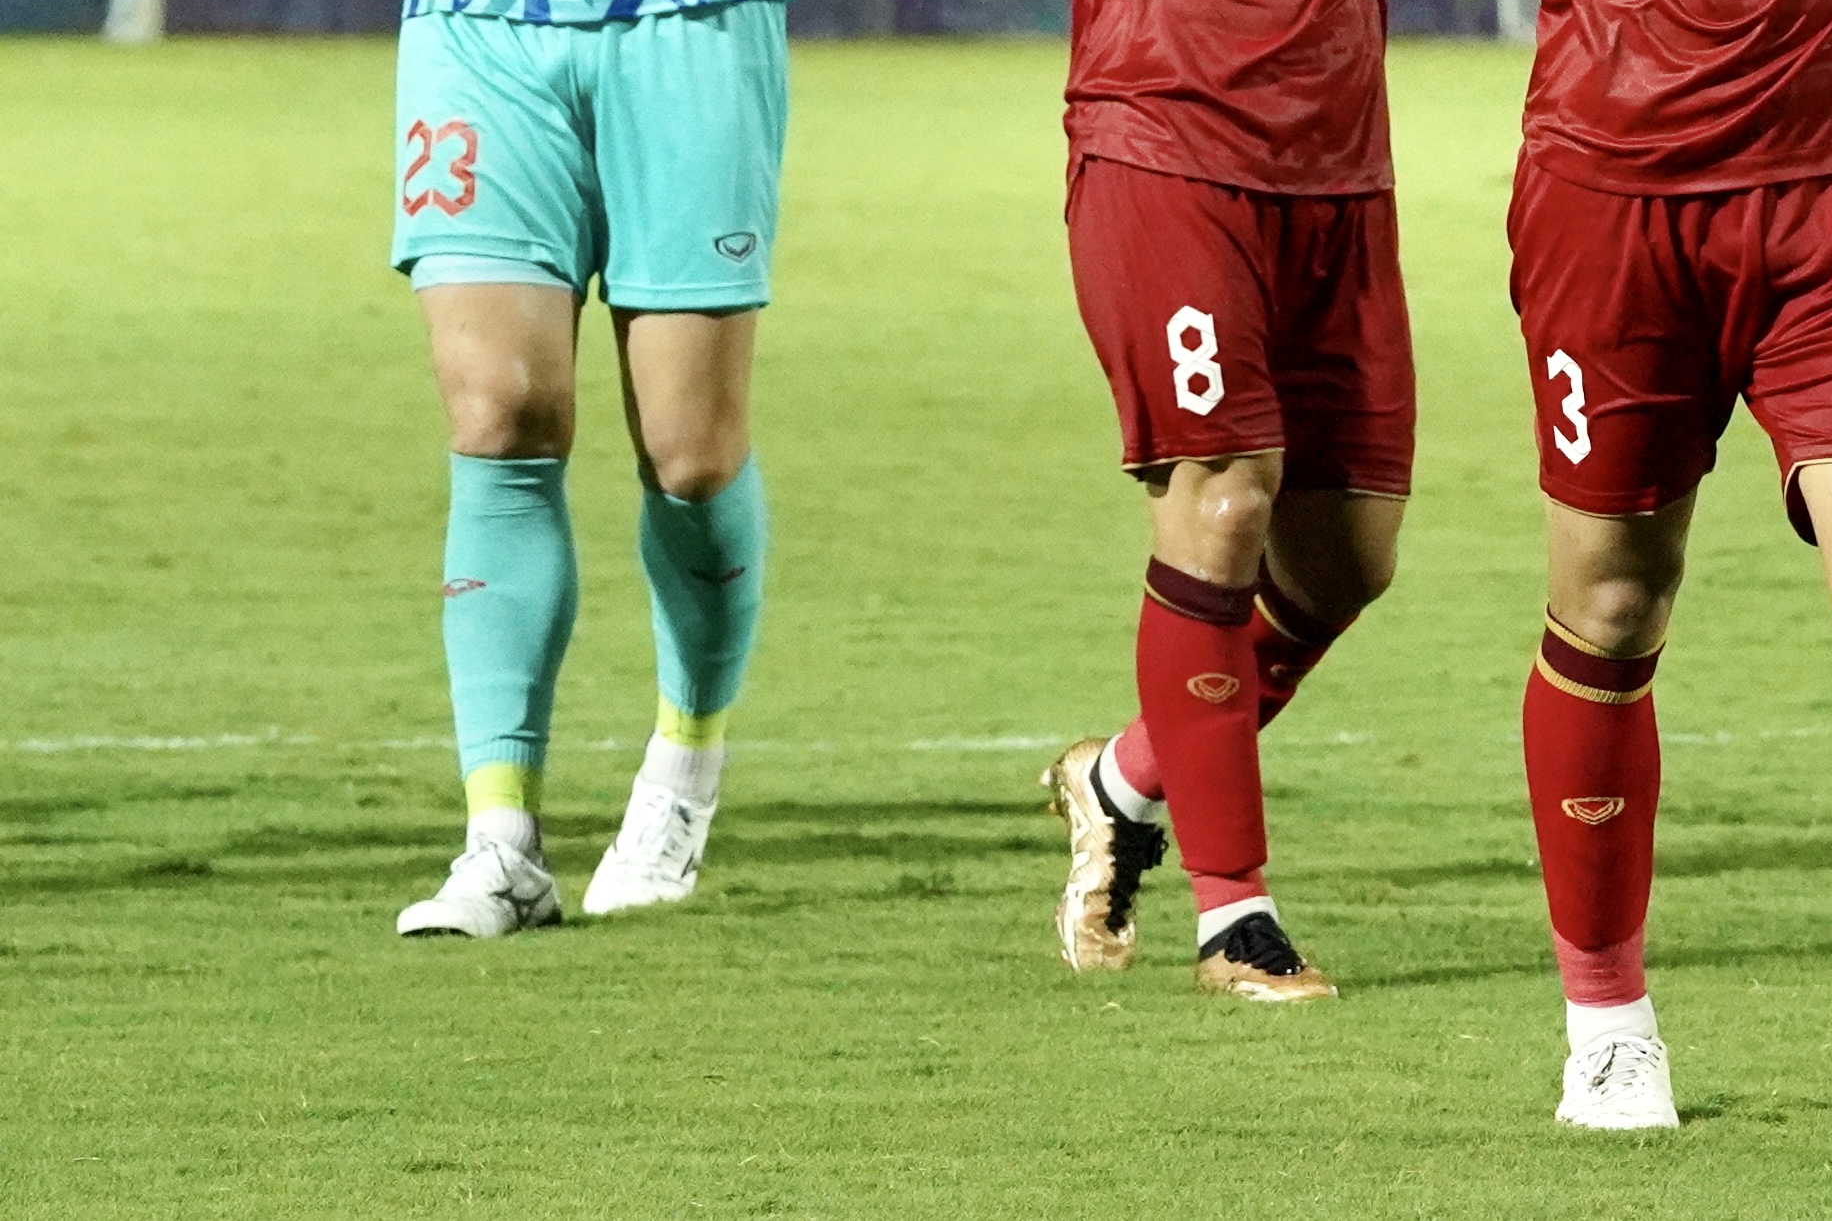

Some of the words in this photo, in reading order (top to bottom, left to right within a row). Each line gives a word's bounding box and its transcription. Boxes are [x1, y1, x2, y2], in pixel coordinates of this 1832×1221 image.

[402, 118, 478, 217] 23
[1166, 305, 1225, 417] 8
[1546, 348, 1592, 465] 3
